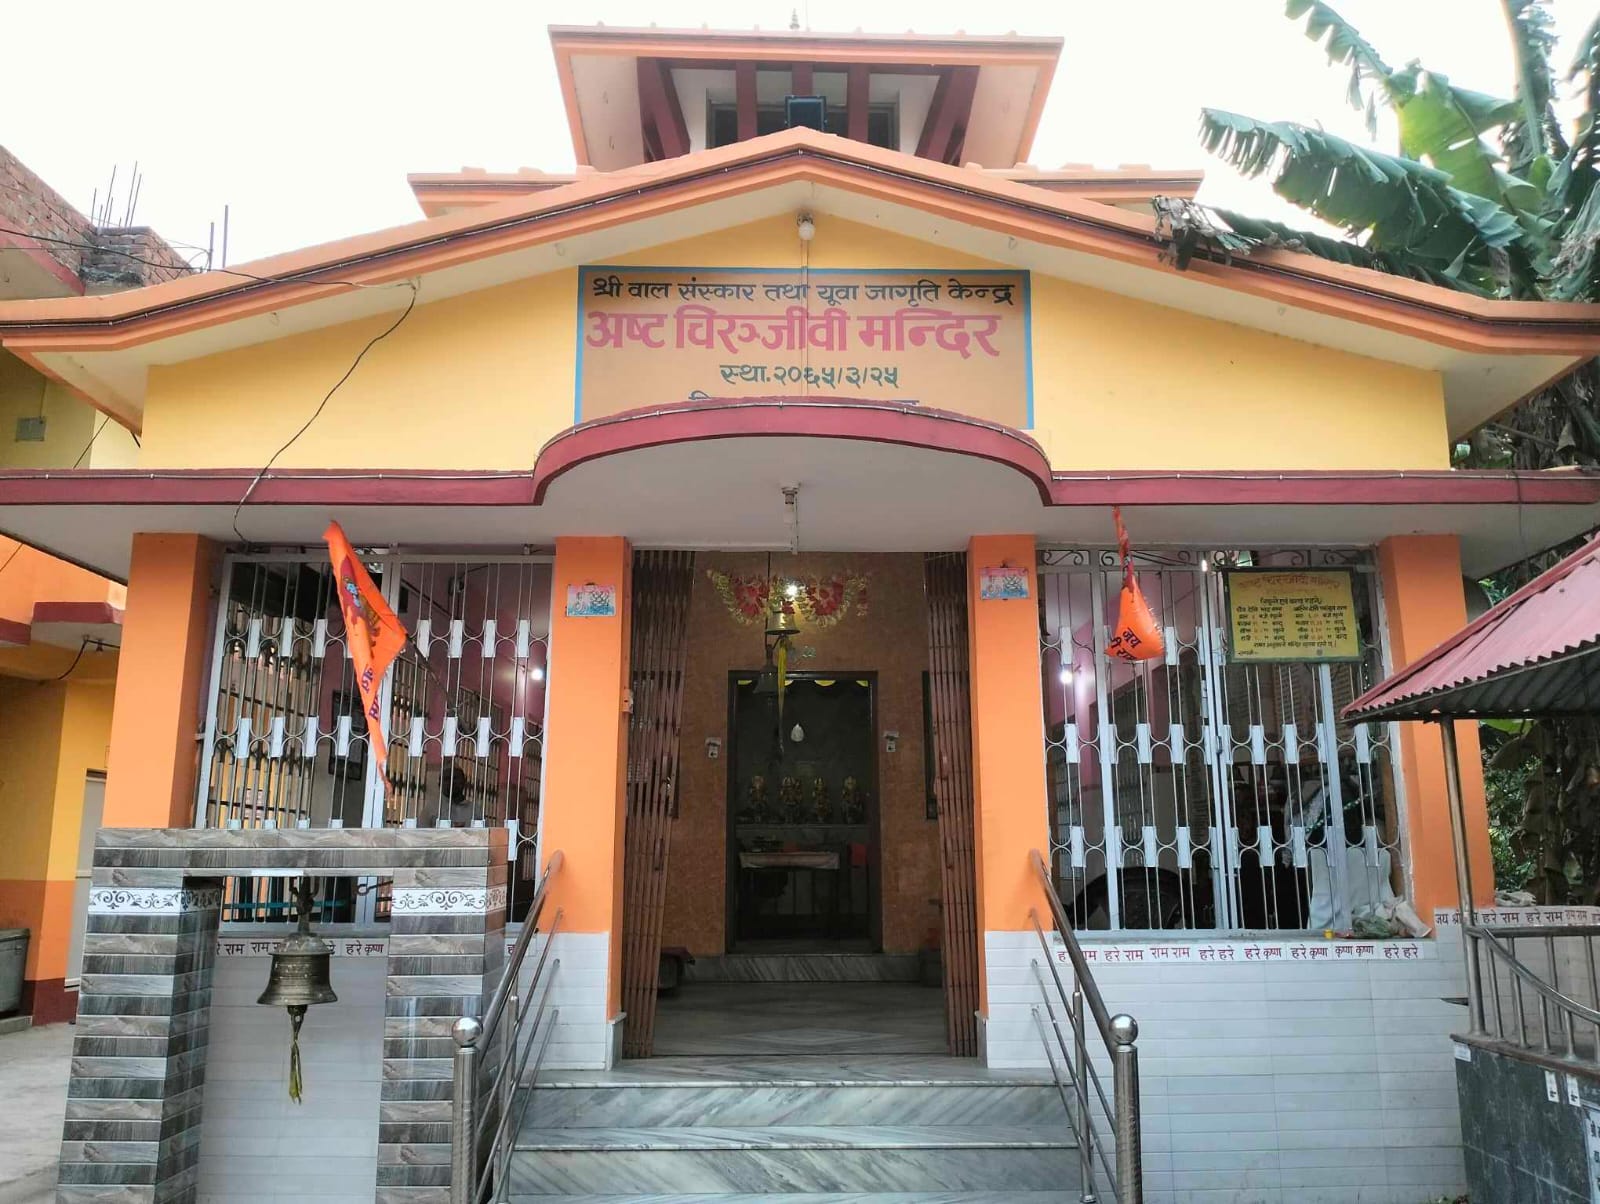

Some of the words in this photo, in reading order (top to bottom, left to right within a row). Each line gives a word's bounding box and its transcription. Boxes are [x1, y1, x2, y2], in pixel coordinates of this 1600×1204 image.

[592, 275, 623, 298] श्री
[677, 277, 756, 301] संस्कार
[763, 283, 809, 301] तथा
[816, 284, 860, 307] यूवा
[865, 279, 942, 308] जागृति
[947, 279, 1015, 306] केन्द्र
[586, 310, 668, 349] अष्ट
[857, 307, 1002, 360] मन्दिर
[1122, 626, 1142, 648] जय
[1481, 909, 1497, 924] हरे
[1500, 912, 1520, 924] राम
[1543, 911, 1563, 922] राम
[224, 944, 245, 955] राम
[250, 942, 271, 954] राम
[345, 940, 362, 955] हरे
[1104, 946, 1120, 962] हरे
[1123, 949, 1144, 961] राम
[1150, 947, 1168, 958] राम
[1172, 947, 1190, 958] राम
[1198, 945, 1215, 960] हरे
[1217, 945, 1235, 960] हरे
[1244, 944, 1261, 960] हरे
[1290, 944, 1307, 959] हरे
[1383, 943, 1399, 959] हरे
[1402, 943, 1418, 959] हरे
